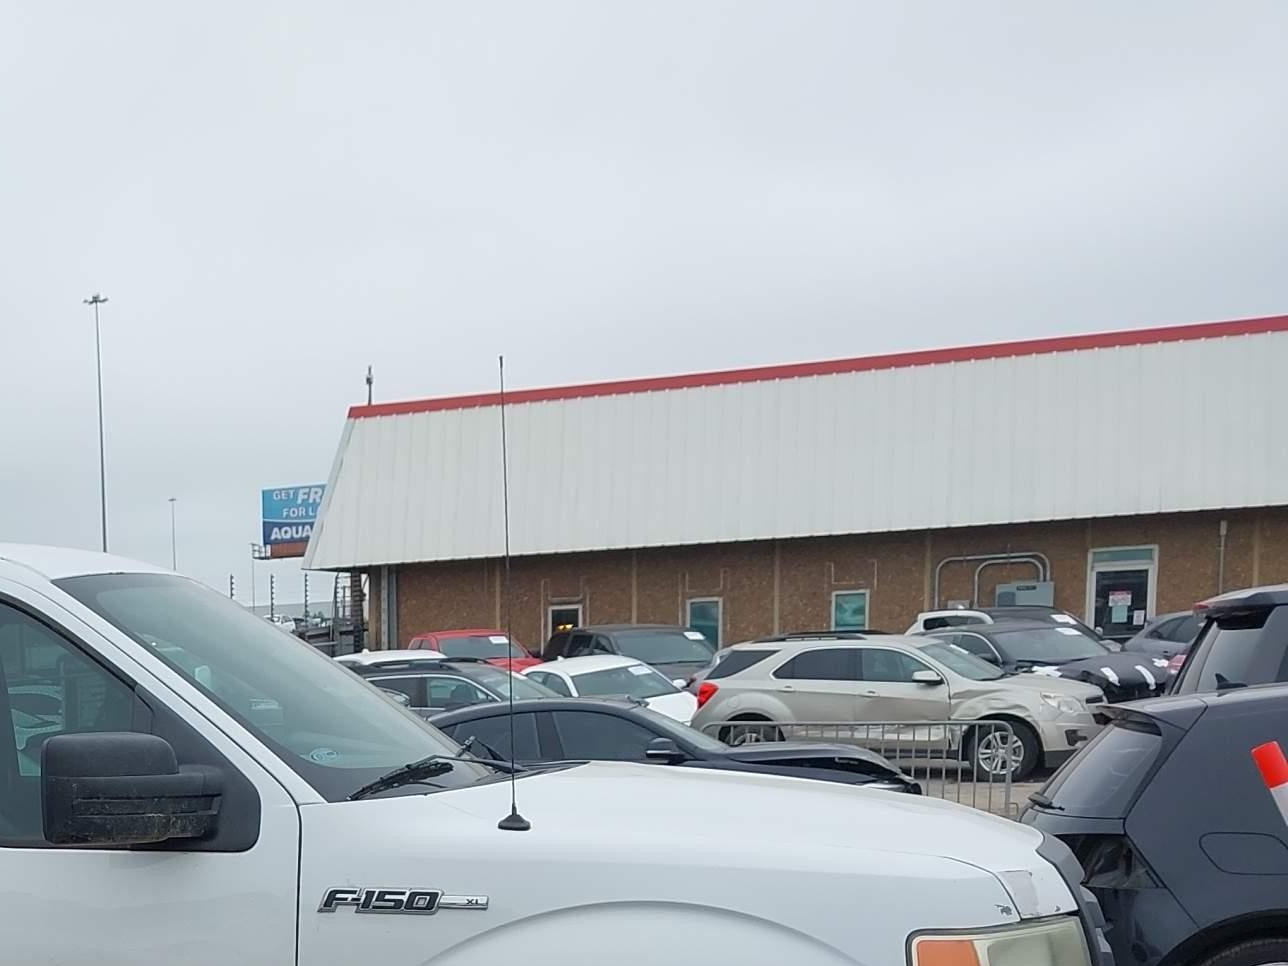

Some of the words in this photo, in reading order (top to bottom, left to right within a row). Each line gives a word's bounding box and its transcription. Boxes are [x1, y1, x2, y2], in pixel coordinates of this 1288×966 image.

[273, 489, 295, 501] GET
[297, 487, 323, 504] FR
[282, 506, 306, 518] FOR
[270, 525, 313, 540] AQUA
[318, 887, 444, 914] F-150
[465, 898, 480, 906] XL
